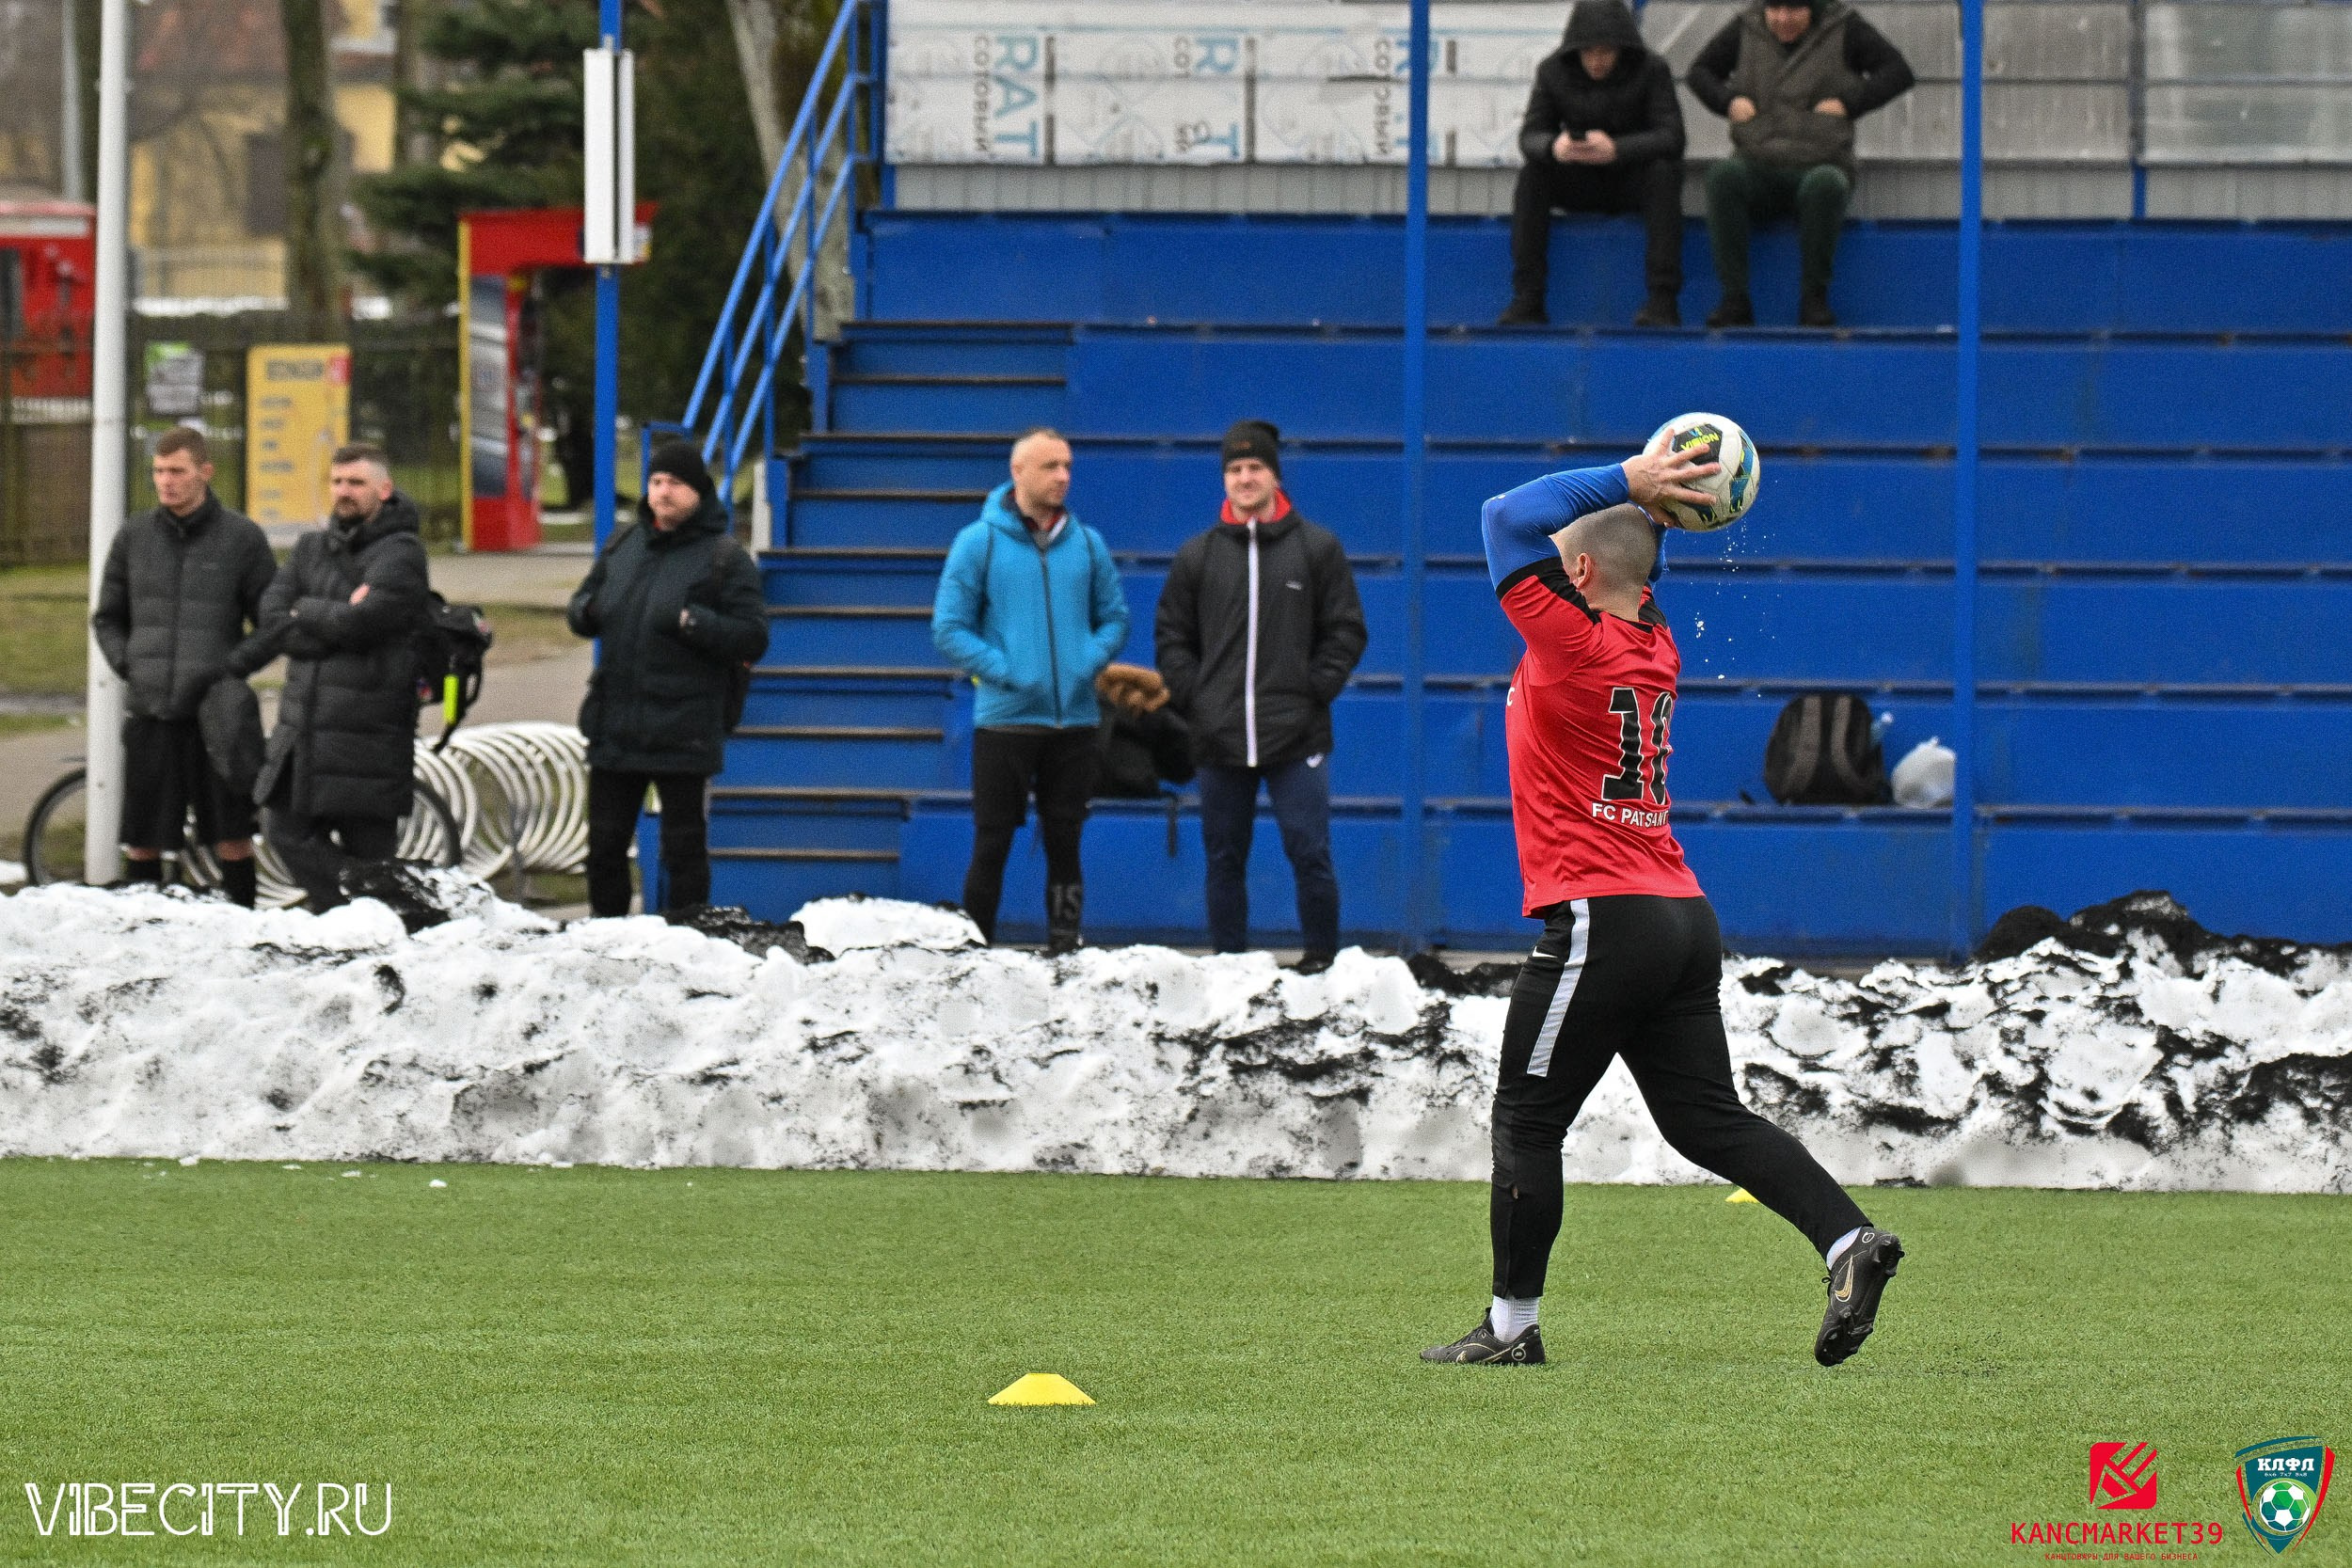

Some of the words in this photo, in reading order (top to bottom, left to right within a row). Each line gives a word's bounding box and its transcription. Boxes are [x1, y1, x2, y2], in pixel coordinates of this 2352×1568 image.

[994, 35, 1040, 158] RAT
[1195, 37, 1240, 159] RT
[1592, 802, 1616, 821] FC
